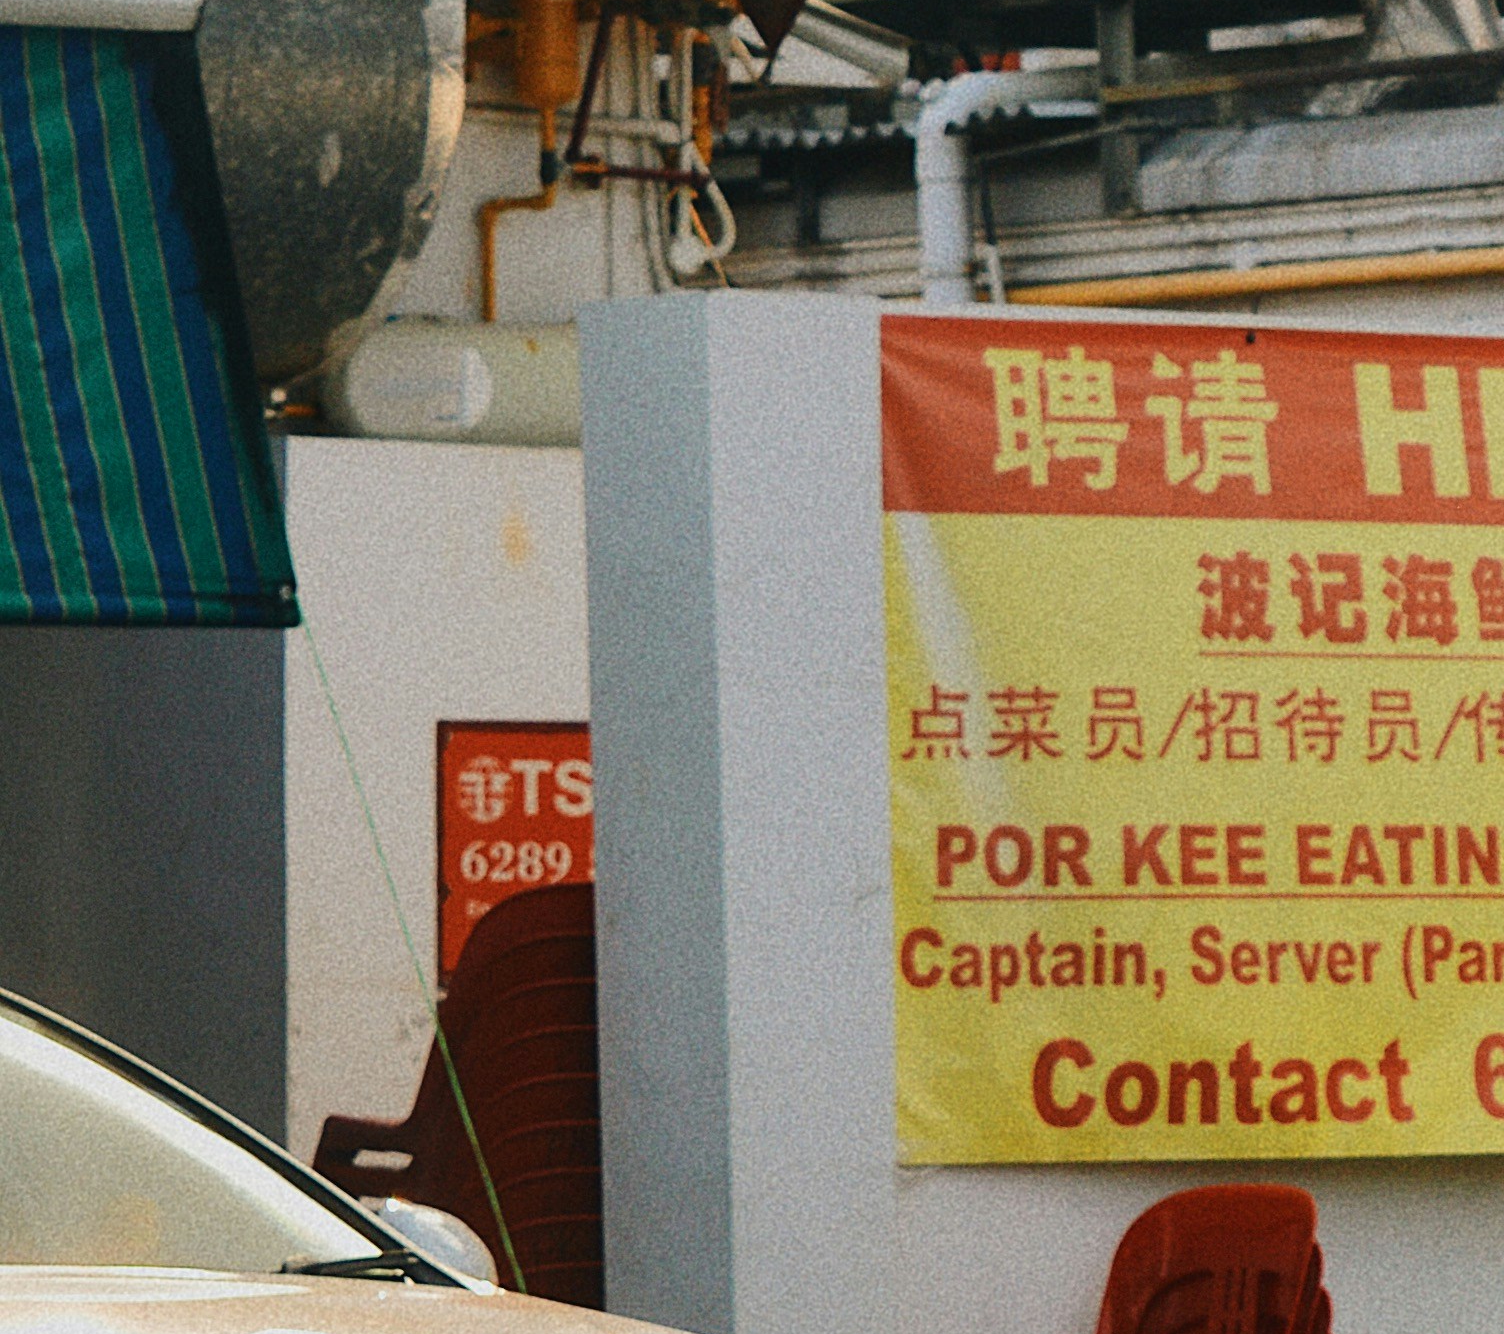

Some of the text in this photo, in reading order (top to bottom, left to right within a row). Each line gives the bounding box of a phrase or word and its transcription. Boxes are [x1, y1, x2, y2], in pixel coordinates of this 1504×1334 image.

[982, 347, 1279, 495] 聘请
[460, 840, 574, 885] 6289
[936, 824, 1093, 888] POR
[1122, 824, 1268, 887] KEE
[901, 926, 1167, 1003] Captain,
[1190, 924, 1382, 985] Server
[1031, 1036, 1416, 1129] Contact
